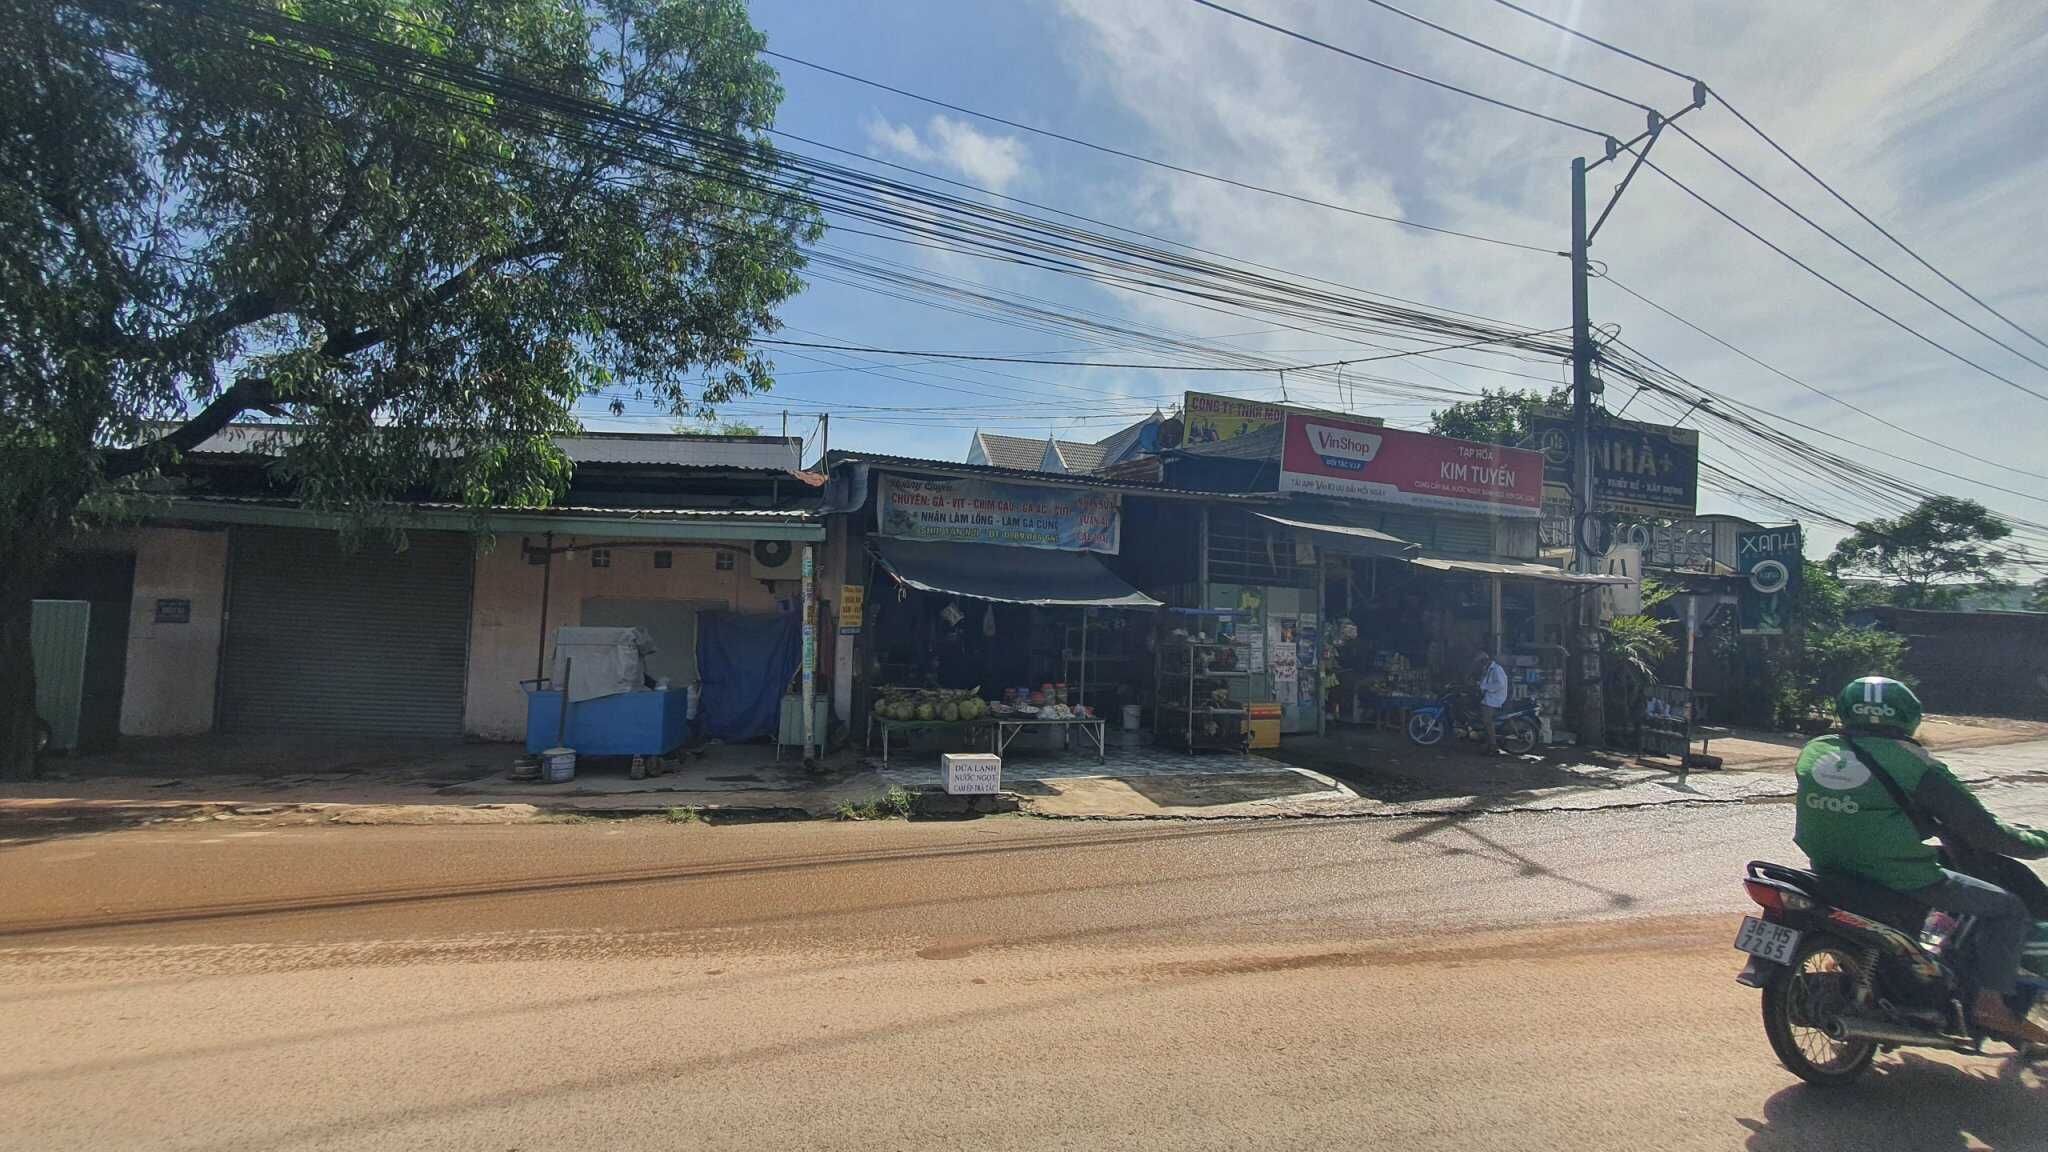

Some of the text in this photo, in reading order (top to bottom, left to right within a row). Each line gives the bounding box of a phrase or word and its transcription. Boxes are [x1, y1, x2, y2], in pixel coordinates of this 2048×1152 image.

[1319, 431, 1370, 456] VinShop
[1440, 461, 1516, 488] KIM TUYẾN
[1852, 703, 1896, 717] Grab
[1805, 793, 1860, 815] Grab
